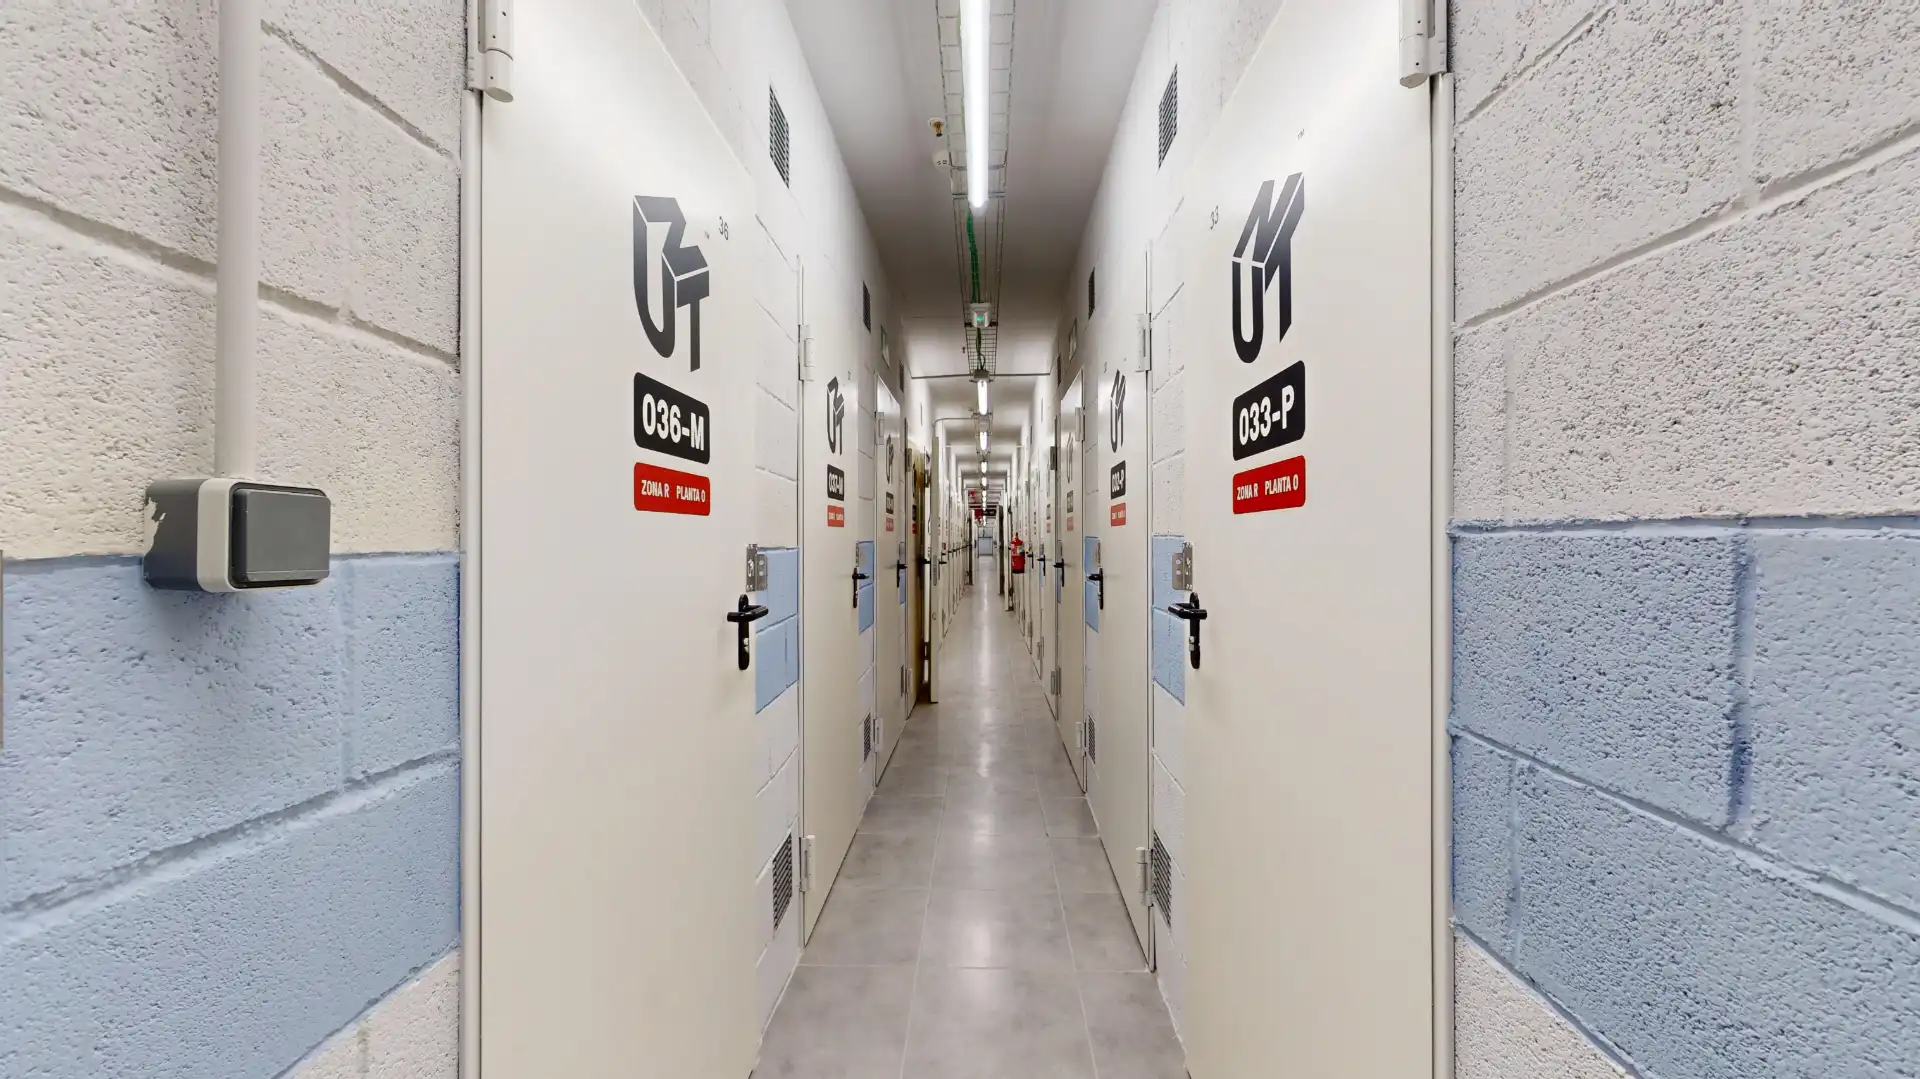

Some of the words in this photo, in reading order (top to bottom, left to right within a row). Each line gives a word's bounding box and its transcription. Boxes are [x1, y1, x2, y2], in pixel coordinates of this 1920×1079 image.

[718, 216, 729, 241] 36
[642, 393, 704, 451] 036-M
[1239, 385, 1295, 445] 033-P
[641, 479, 663, 498] ZONA
[664, 483, 670, 498] R
[676, 485, 701, 502] PLANTA
[1236, 484, 1253, 500] ZONA
[1253, 482, 1259, 497] R
[1264, 475, 1292, 495] PLANTA
